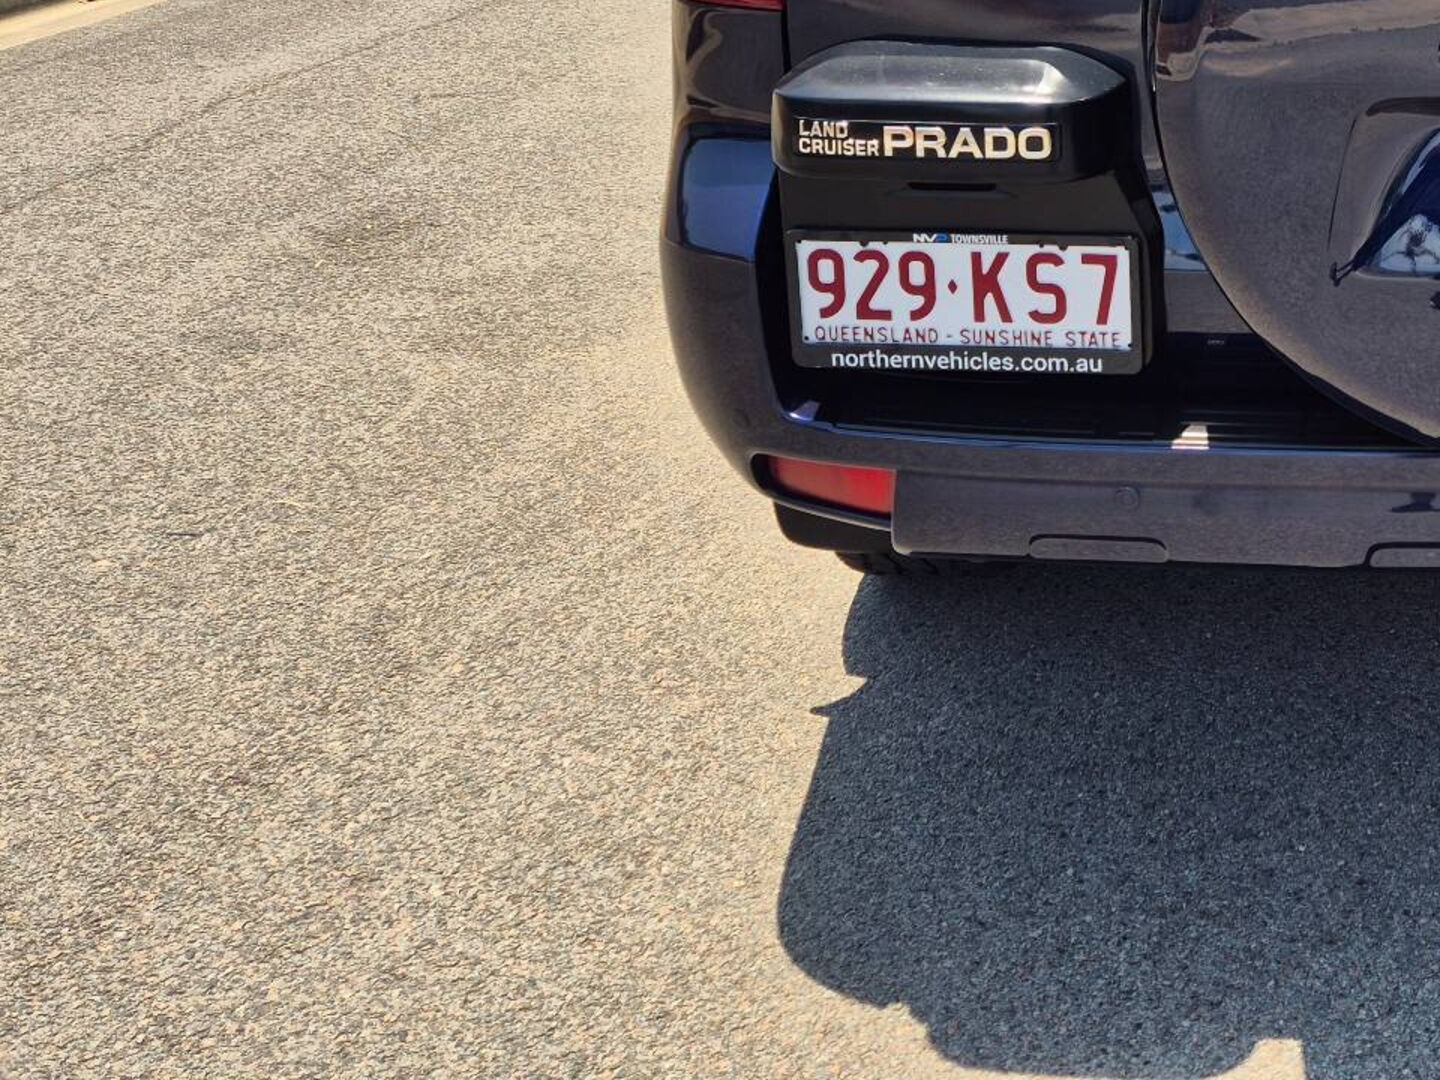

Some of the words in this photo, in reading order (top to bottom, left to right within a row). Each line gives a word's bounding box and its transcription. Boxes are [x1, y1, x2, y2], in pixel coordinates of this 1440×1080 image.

[799, 120, 849, 138] LAND
[799, 138, 879, 157] CRUISER
[883, 126, 1052, 159] PRADO
[951, 234, 1008, 244] TOWNSVILLE
[815, 326, 938, 343] QUEENSLAND
[960, 330, 1053, 347] SUNSHINE
[1065, 332, 1121, 348] STATE
[831, 350, 1103, 373] northernvehicles.com.au
